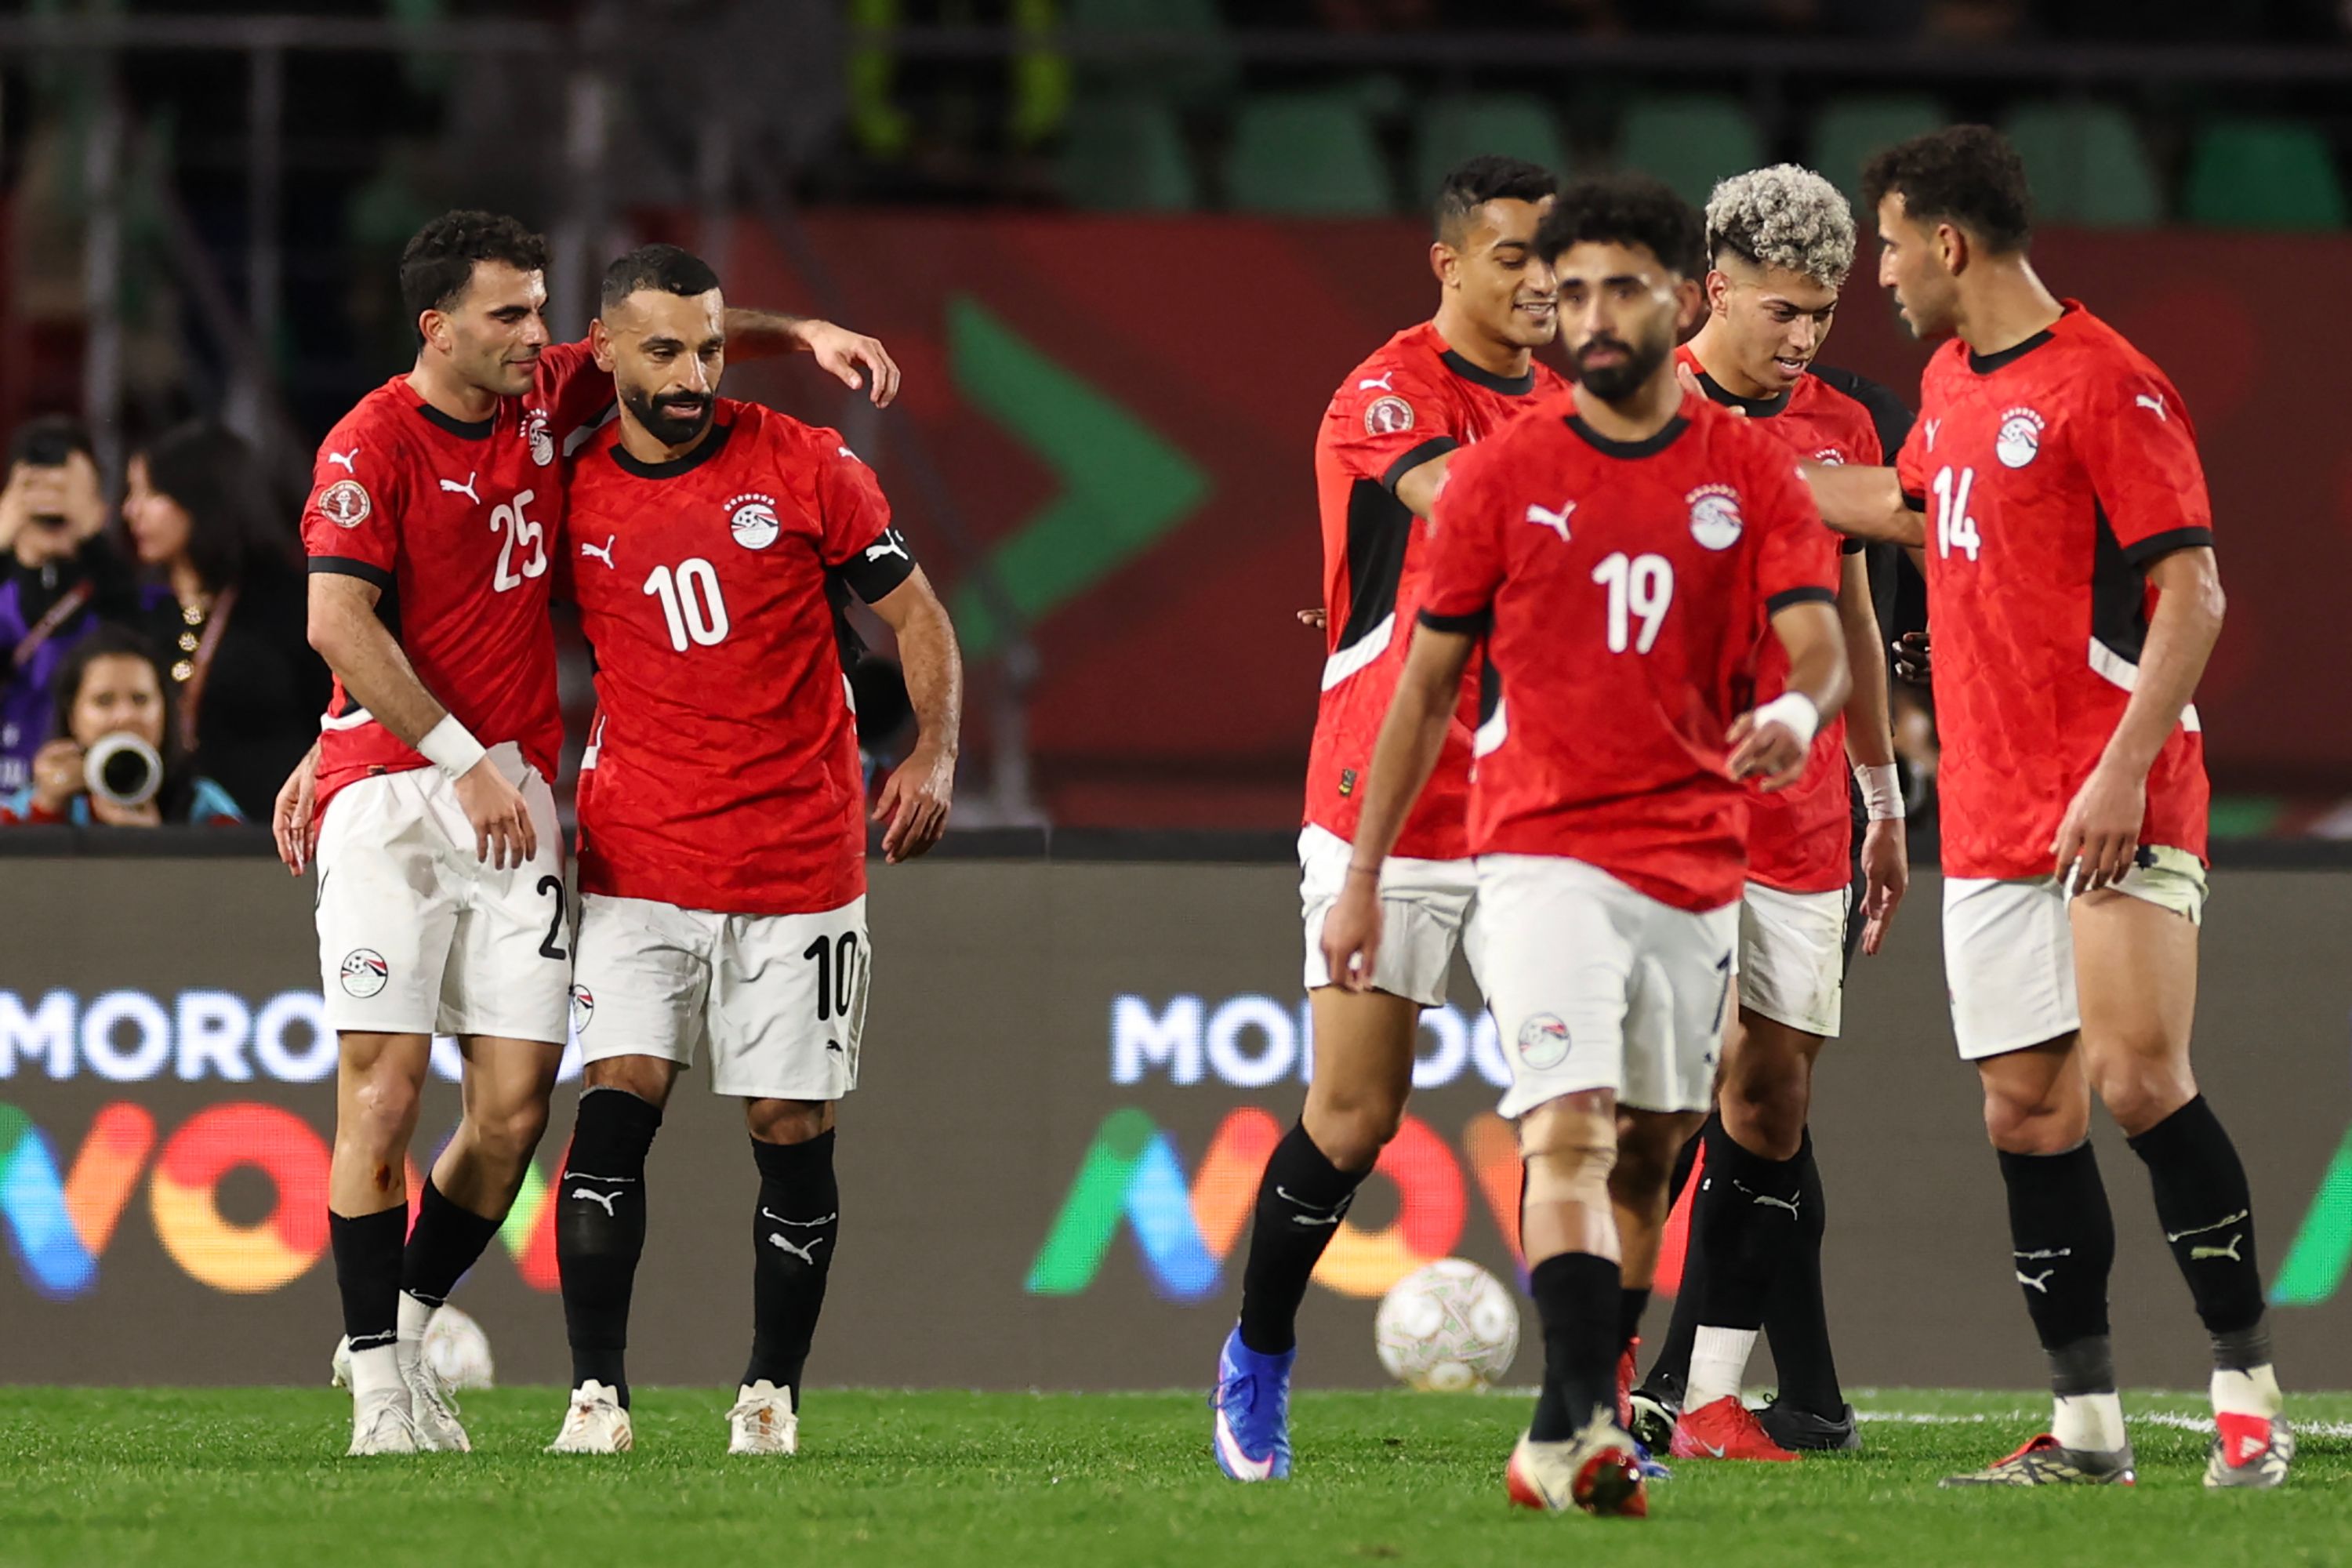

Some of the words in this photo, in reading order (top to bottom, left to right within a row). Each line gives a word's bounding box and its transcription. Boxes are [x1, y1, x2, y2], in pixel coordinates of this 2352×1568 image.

[489, 488, 548, 593] 25
[1933, 466, 1981, 561] 14
[642, 557, 730, 652] 10
[1592, 551, 1675, 655] 19
[536, 874, 573, 961] 2
[803, 931, 858, 1022] 10
